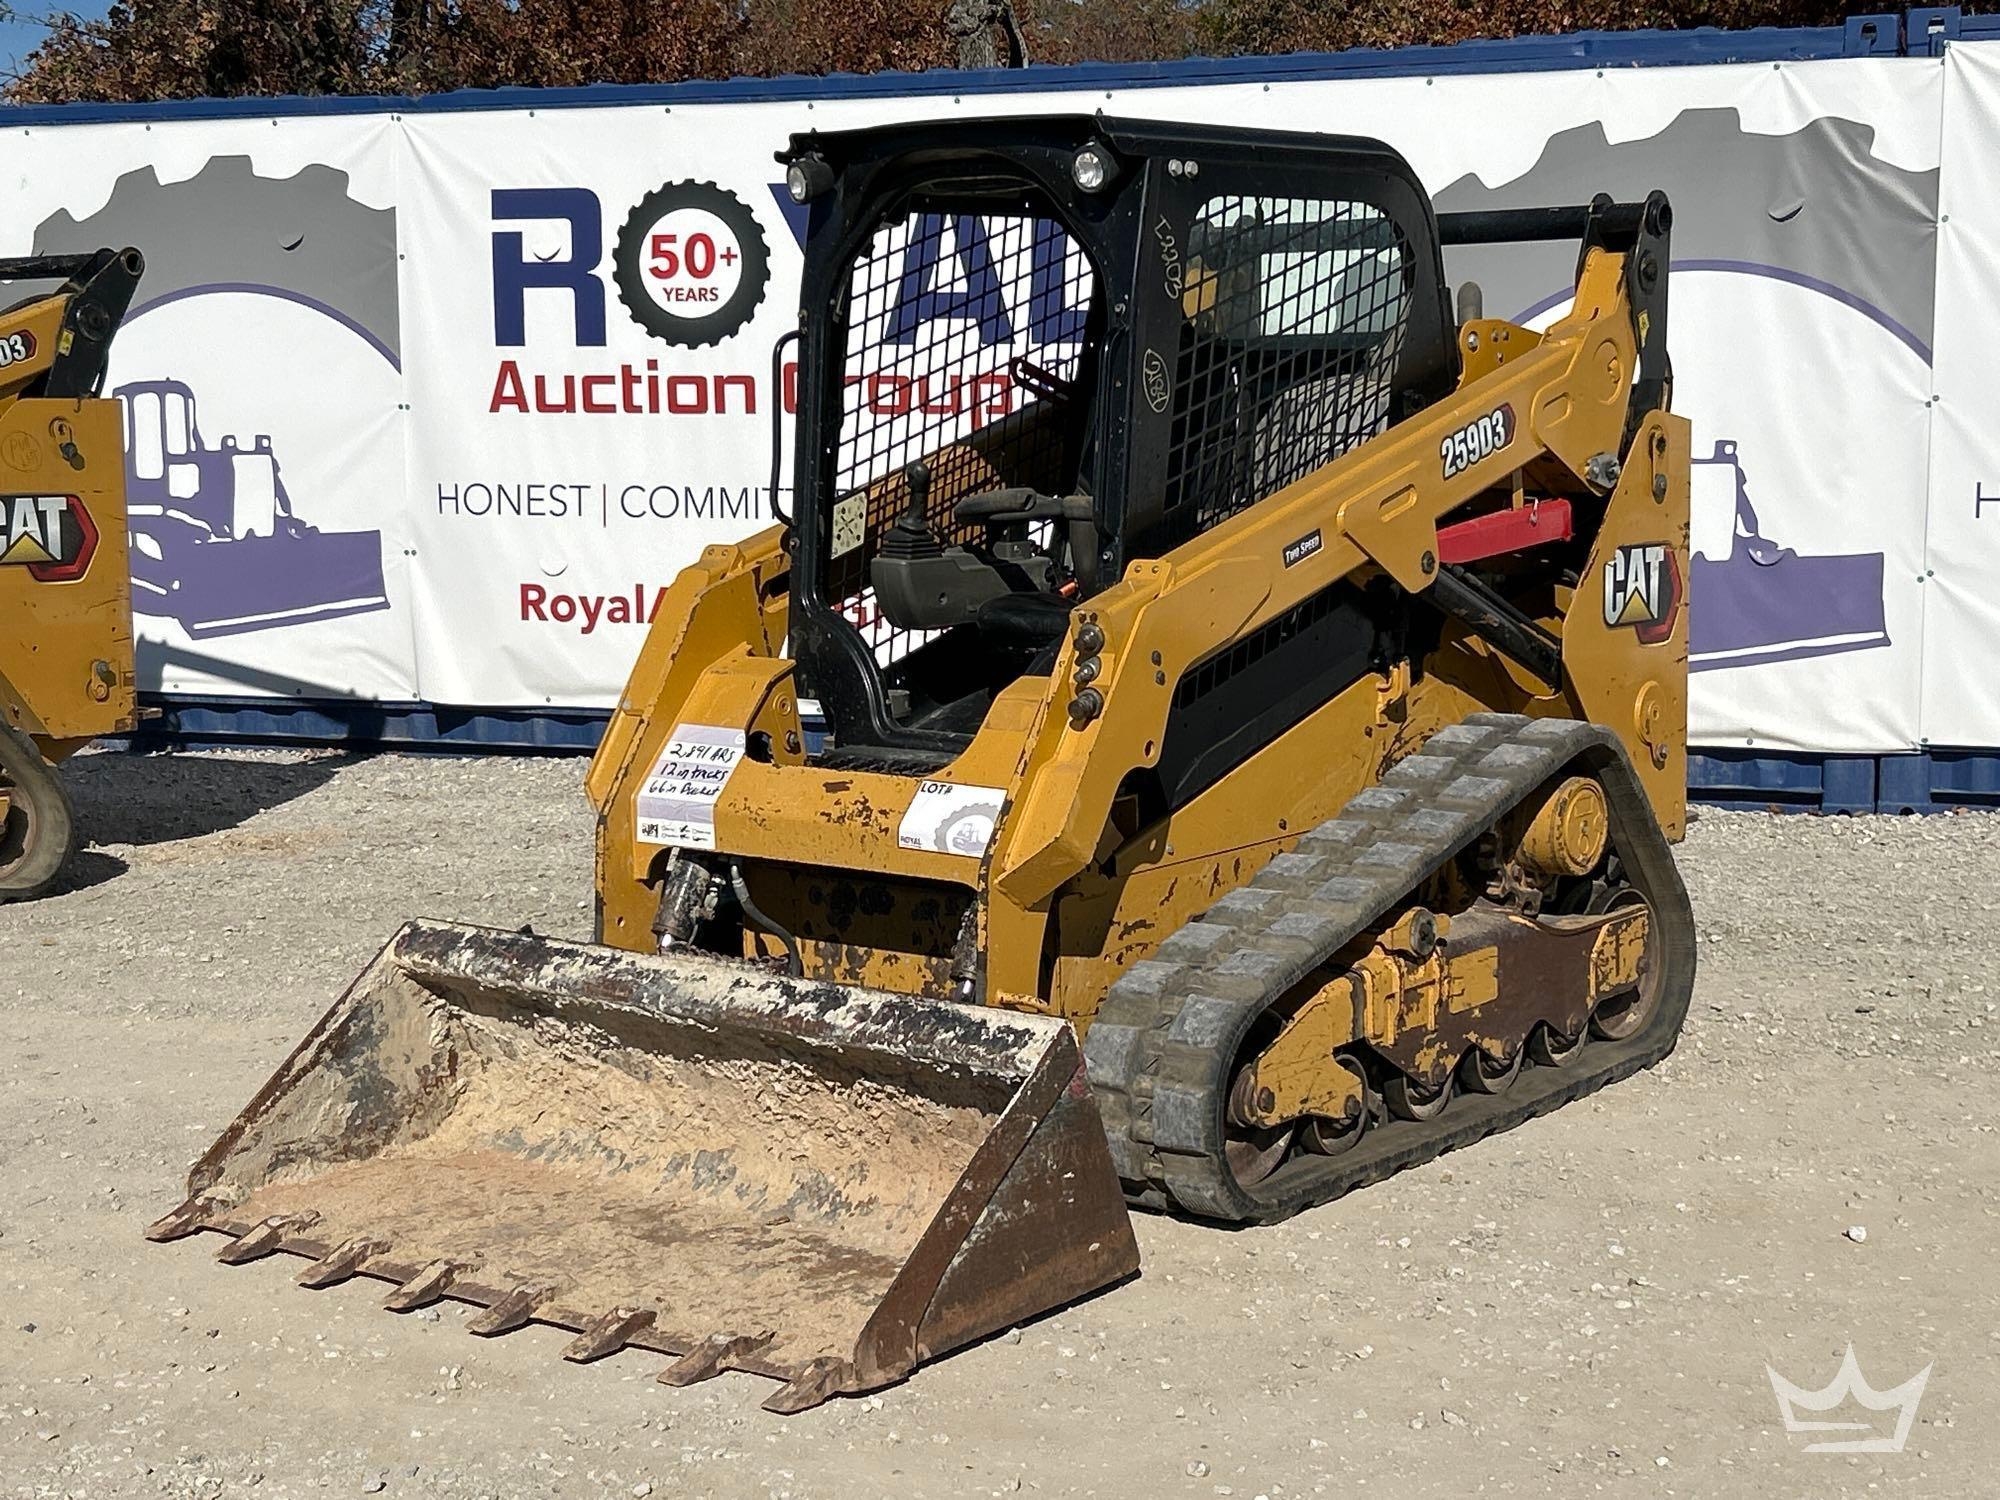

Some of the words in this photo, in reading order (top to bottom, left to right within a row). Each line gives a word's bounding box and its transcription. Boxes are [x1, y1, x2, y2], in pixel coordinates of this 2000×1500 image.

[649, 233, 737, 279] 50+
[663, 287, 719, 302] YEARS
[489, 359, 756, 414] Auction
[1441, 410, 1506, 478] 259D3
[438, 483, 591, 516] HONEST
[0, 497, 68, 561] AT
[519, 583, 667, 634] Royal
[1604, 546, 1665, 624] CAT
[660, 762, 677, 776] 12
